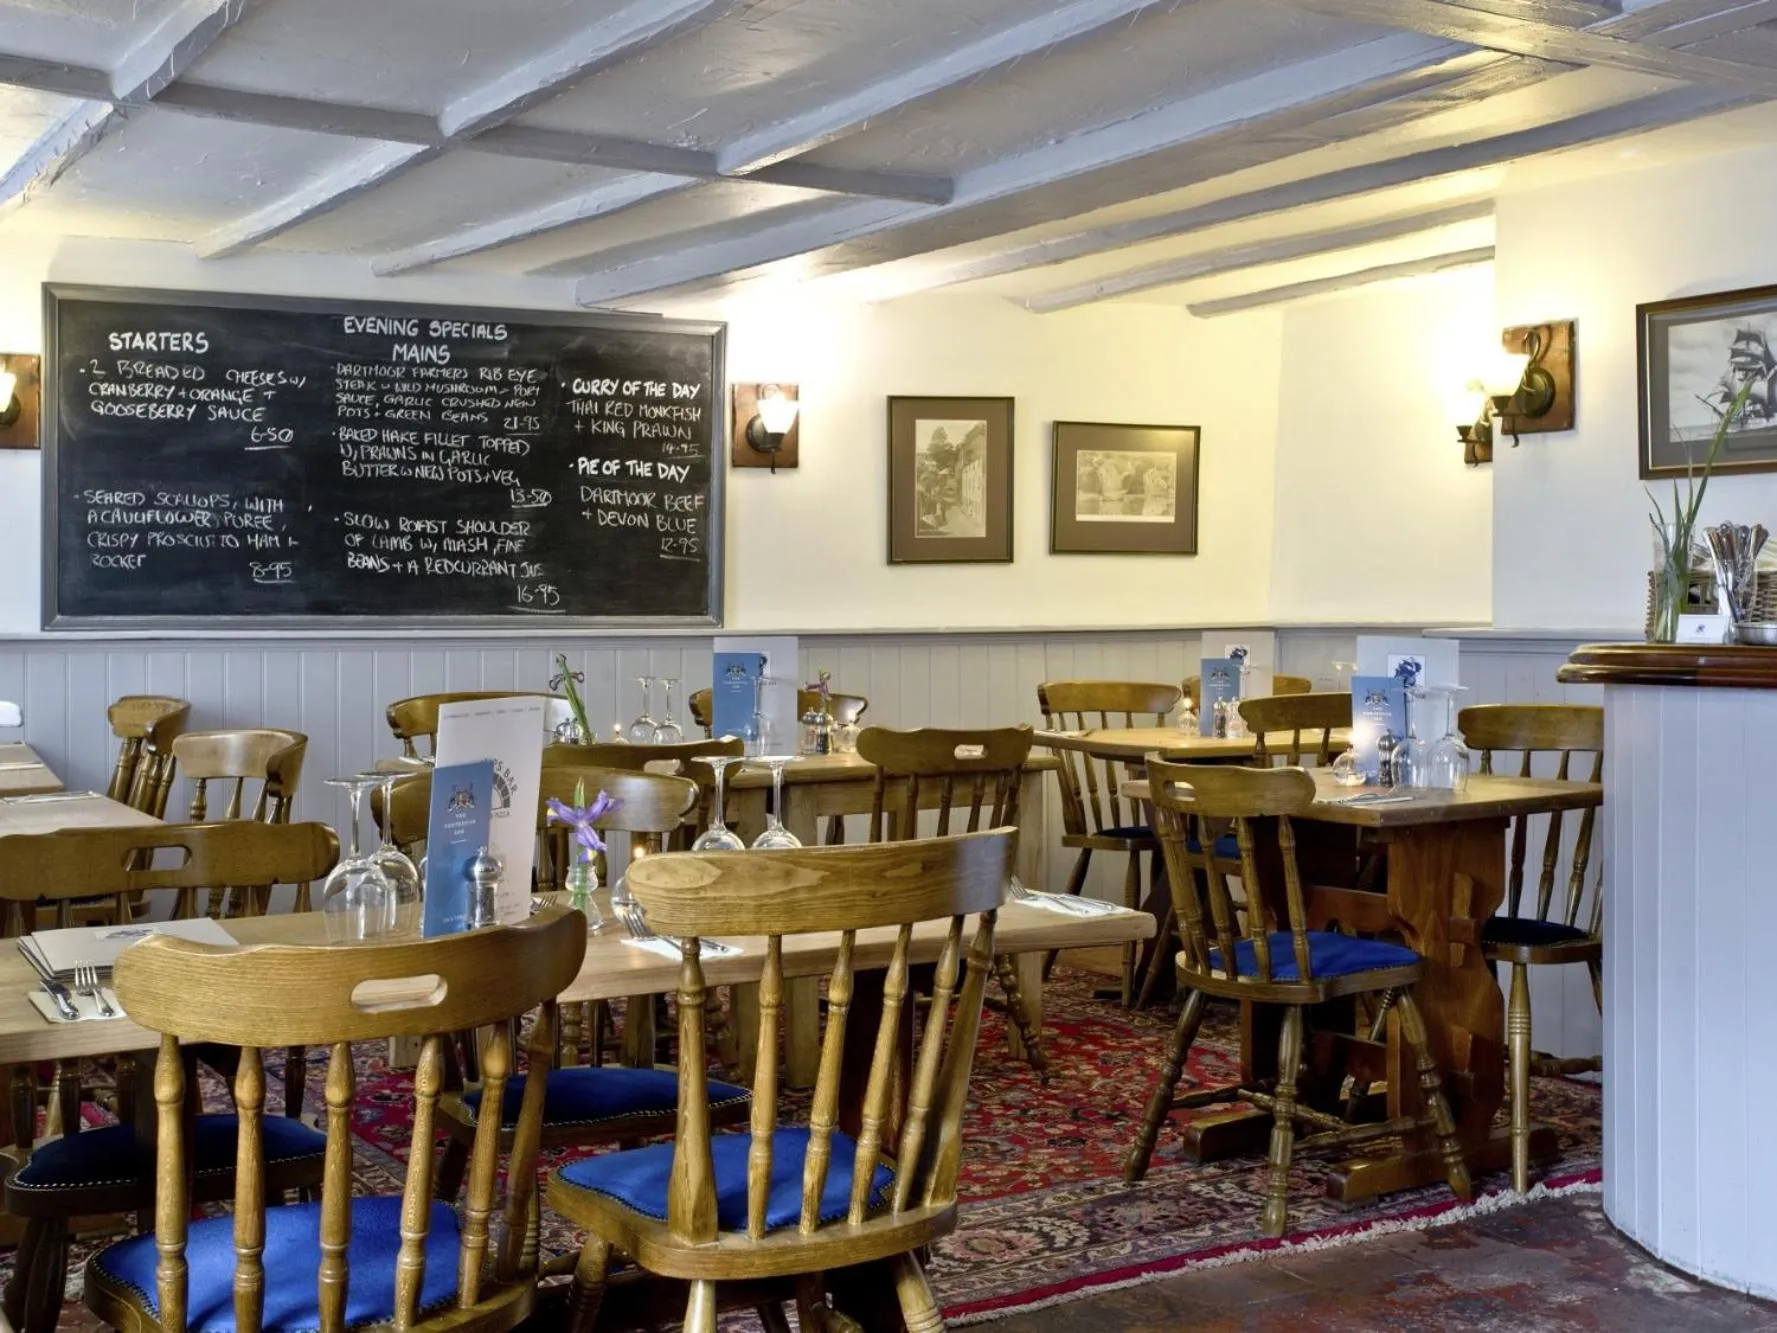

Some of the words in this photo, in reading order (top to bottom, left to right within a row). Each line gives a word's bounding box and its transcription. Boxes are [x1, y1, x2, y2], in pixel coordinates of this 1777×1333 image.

[344, 316, 419, 337] EVENING
[429, 320, 508, 340] SPECIALS
[109, 331, 209, 353] STARTERS
[392, 343, 451, 364] MAINS
[90, 359, 107, 374] 2
[117, 360, 205, 380] BREADED
[226, 369, 287, 386] CHEESES
[479, 367, 502, 381] RIB
[508, 368, 539, 383] EYE
[89, 382, 176, 399] CRANBERRY
[336, 378, 377, 391] STEAK
[425, 383, 498, 395] MUSHROOM
[572, 378, 619, 396] CURRY
[622, 381, 640, 396] OF
[643, 381, 666, 397] THE
[672, 382, 700, 399] DAY
[91, 400, 197, 420] GOOSEBERRY
[208, 406, 266, 422] SAUCE
[384, 394, 432, 407] GARLIC
[441, 396, 501, 408] CRUSHED
[566, 400, 598, 415] THAI
[604, 401, 634, 418] RED
[639, 404, 700, 422] MONKFISH
[337, 405, 371, 419] POTS
[385, 409, 431, 421] GREEN
[441, 411, 489, 423] BEANS
[591, 419, 625, 438] KING
[633, 421, 692, 440] PRAWN
[339, 426, 378, 442] BAKED
[382, 429, 418, 445] HAKE
[424, 431, 471, 448] FILLET
[478, 434, 531, 456] TOPPED
[360, 444, 417, 461] PRAWNS
[421, 451, 435, 462] IN
[439, 449, 491, 466] GARLIC
[341, 460, 399, 478] BUTTER
[415, 465, 444, 481] NEW
[448, 467, 483, 484] POTS
[577, 456, 600, 475] PIE
[602, 459, 621, 475] OF
[625, 460, 653, 476] THE
[657, 463, 690, 483] DAY
[84, 490, 146, 506] SEARED
[245, 497, 283, 513] WITH
[580, 485, 658, 509] DARTMOOR
[664, 494, 706, 512] BEEF
[344, 512, 390, 530] SLOW
[399, 516, 448, 534] ROAST
[456, 520, 531, 535] SHOULDER
[597, 508, 649, 529] DEVON
[656, 514, 697, 534] BLUE
[87, 532, 139, 549] CRISPY
[247, 533, 280, 550] HAM
[344, 533, 365, 547] OF
[373, 535, 414, 551] LAMB
[347, 552, 390, 573] BEANS
[408, 561, 419, 575] A
[425, 556, 516, 579] REDCURRANT
